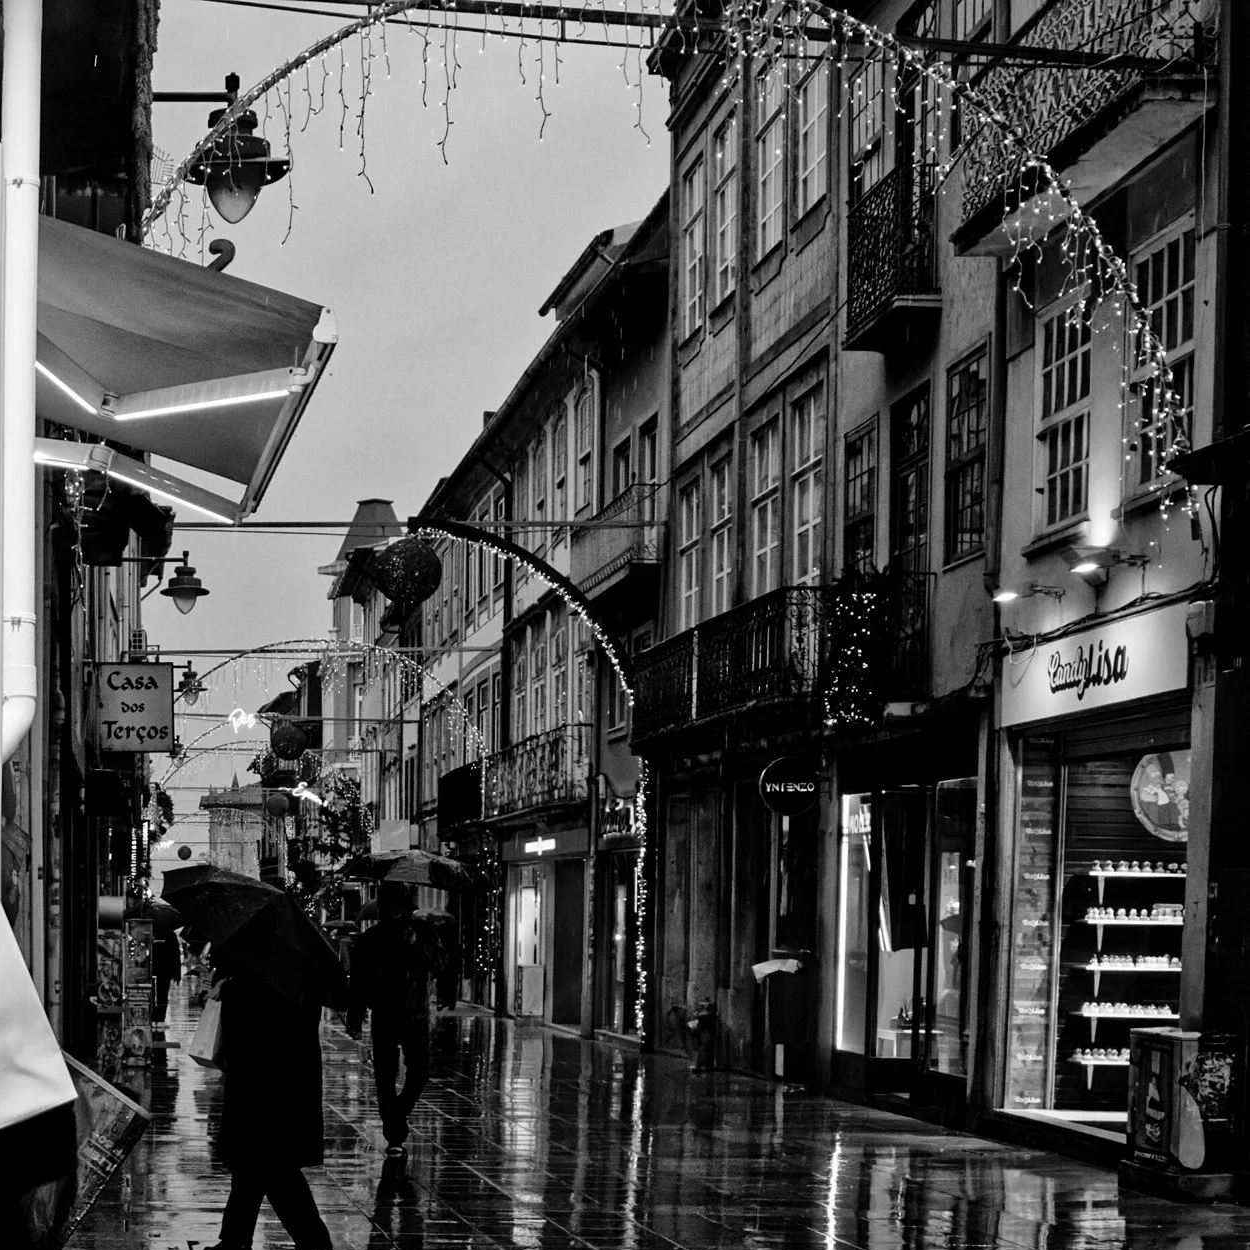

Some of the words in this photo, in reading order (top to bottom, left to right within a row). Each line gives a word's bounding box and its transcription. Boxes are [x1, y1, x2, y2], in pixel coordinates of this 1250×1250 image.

[107, 671, 159, 691] Casa
[121, 701, 146, 713] dos
[101, 720, 169, 745] Terços
[765, 782, 815, 792] YNTENZO
